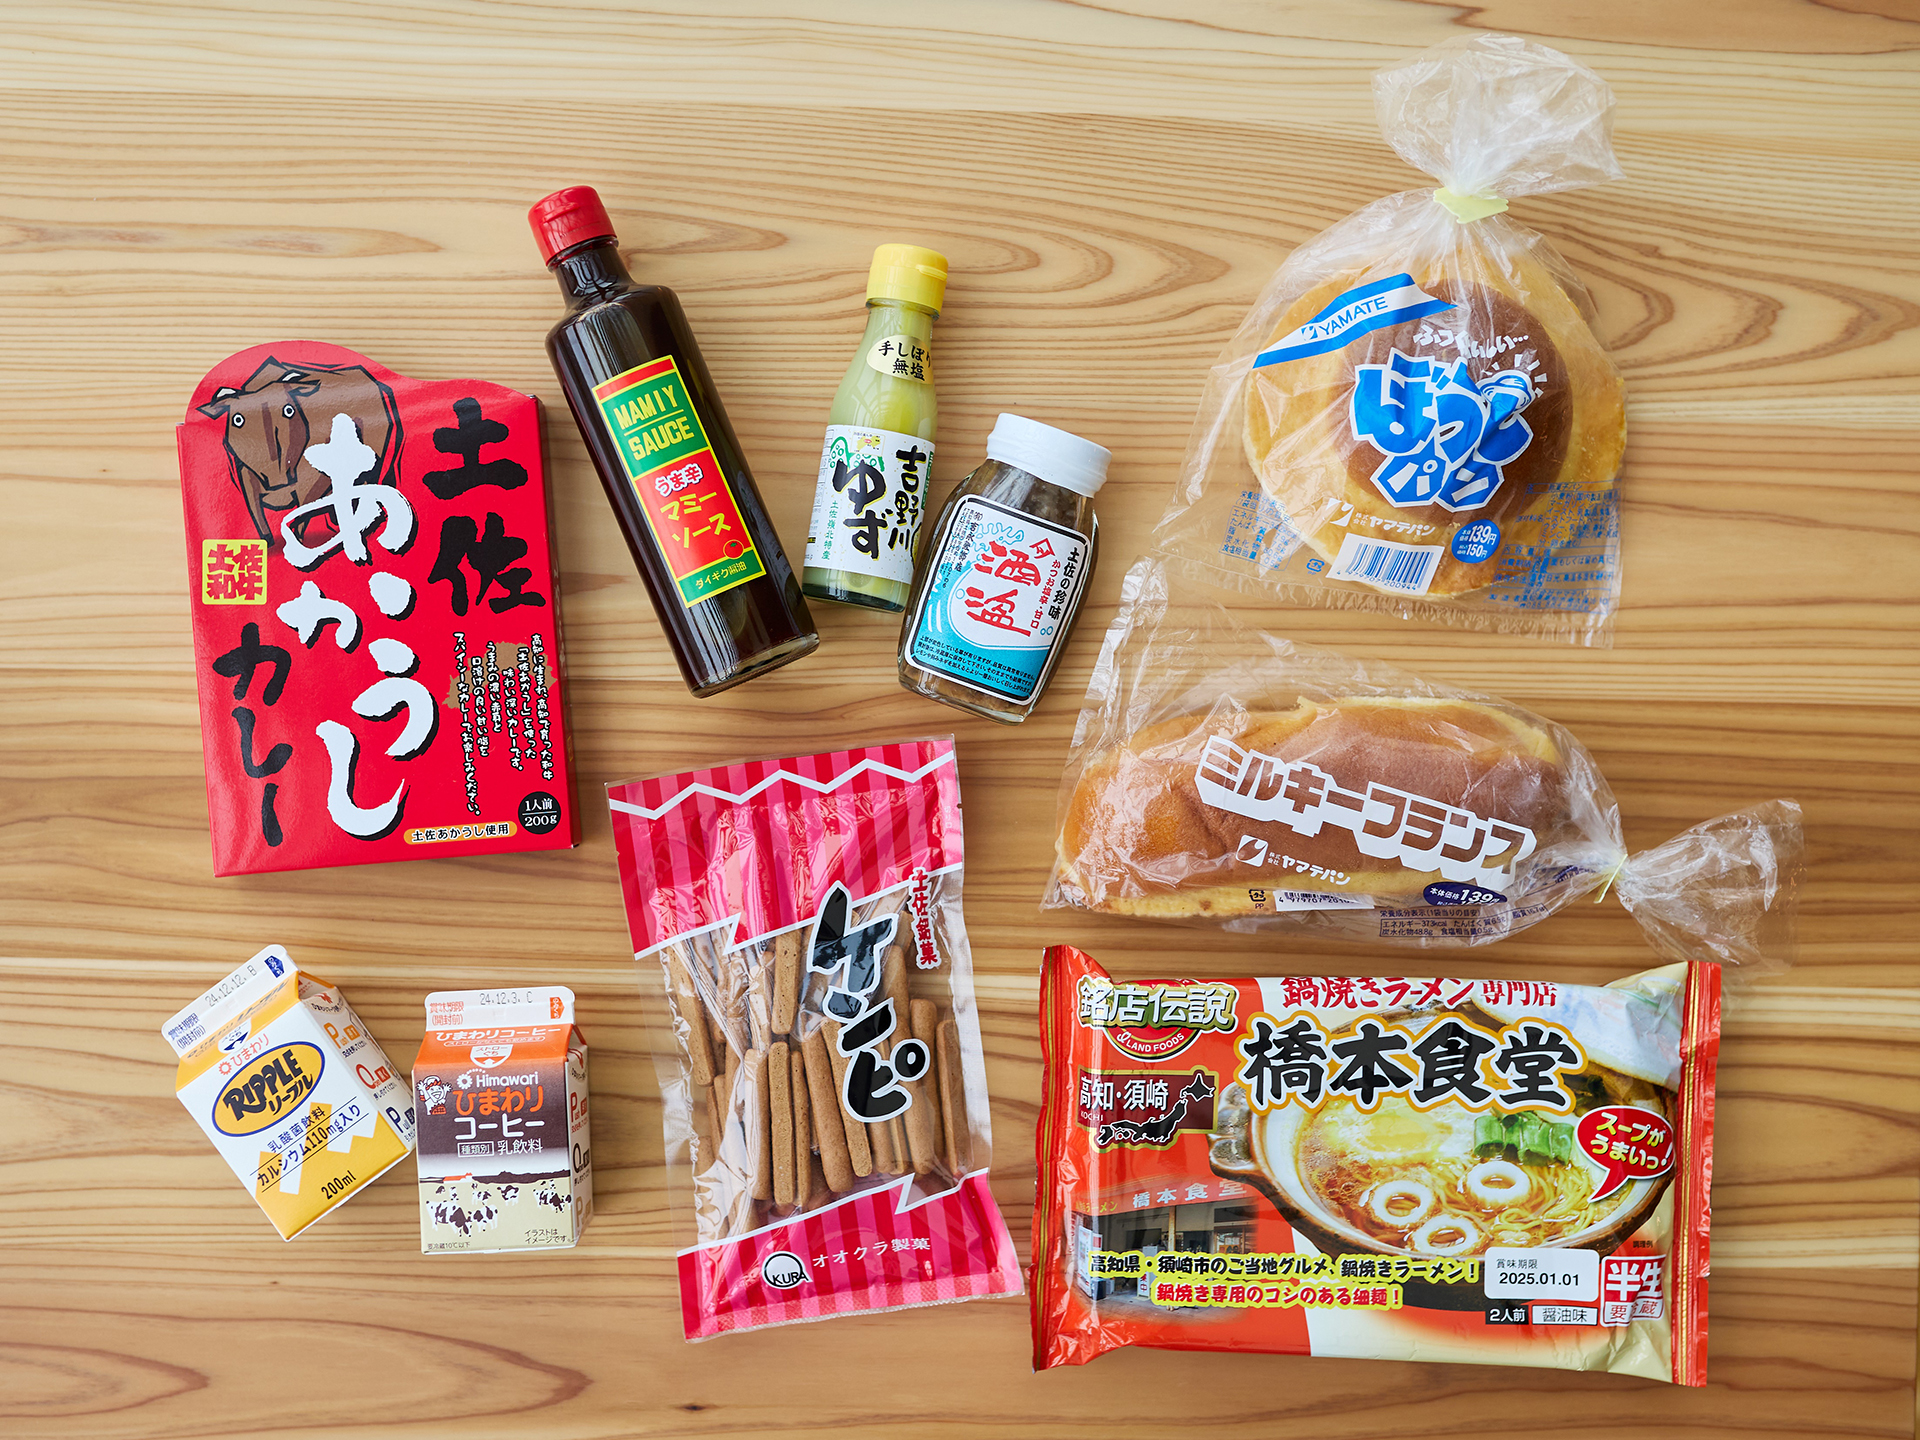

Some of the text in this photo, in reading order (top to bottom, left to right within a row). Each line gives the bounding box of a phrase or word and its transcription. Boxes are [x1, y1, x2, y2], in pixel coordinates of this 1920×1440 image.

[1318, 297, 1388, 336] YAMATE
[892, 358, 926, 382] 無塩
[628, 416, 694, 461] SAUCE
[654, 463, 703, 497] うま辛
[1373, 455, 1501, 510] パン
[423, 398, 545, 616] 土佐
[660, 492, 717, 521] マミー
[832, 459, 893, 560] ゆず
[672, 512, 731, 549] ソース
[1370, 516, 1435, 536] ヤマテパン
[1048, 547, 1080, 620] 土佐の珍味
[276, 413, 439, 838] あかうし
[213, 622, 293, 847] カレー
[525, 797, 553, 811] 1人前
[1197, 737, 1535, 882] ミルキーフランス
[411, 823, 510, 844] 土佐あかうし使用
[524, 814, 557, 827] 200g
[1282, 855, 1350, 885] ヤマテパン
[1430, 887, 1459, 901] 本体価格
[911, 869, 938, 966] 土佐銘菓
[430, 1001, 464, 1013] 賞味期限
[807, 881, 929, 1122] ケンピ
[1080, 982, 1231, 1025] 銘店伝説
[1282, 977, 1557, 1008] 鍋焼きラーメン 専門店
[432, 1014, 463, 1026] (開封前)
[436, 1028, 561, 1041] ひまわりコーヒー
[230, 1033, 269, 1066] ひまわり
[1153, 1033, 1185, 1052] FOODS
[1243, 1020, 1578, 1107] 橋本食堂
[223, 1049, 303, 1121] RIPPLE
[476, 1071, 538, 1087] Himawari
[1080, 1076, 1169, 1111] 高知・須崎
[453, 1086, 543, 1116] ひまわり
[267, 1106, 325, 1153] 乳酸菌飲料
[454, 1113, 545, 1139] コーヒー
[1596, 1111, 1666, 1147] スープが
[257, 1104, 360, 1186] カルシウム110mg入り
[461, 1139, 542, 1155] 種類別 乳飲料
[321, 1169, 357, 1199] 200ml
[1133, 1180, 1247, 1208] 橋本食堂
[813, 1238, 930, 1268] オオクラ製菓
[1496, 1259, 1538, 1269] 賞味期限
[1157, 1283, 1400, 1305] 鍋焼き専用のコシのある細麺!
[1499, 1273, 1579, 1286] 2025.01.01
[1606, 1261, 1663, 1302] 半生
[1489, 1308, 1525, 1322] 2人前
[1543, 1308, 1587, 1323] 醤油味
